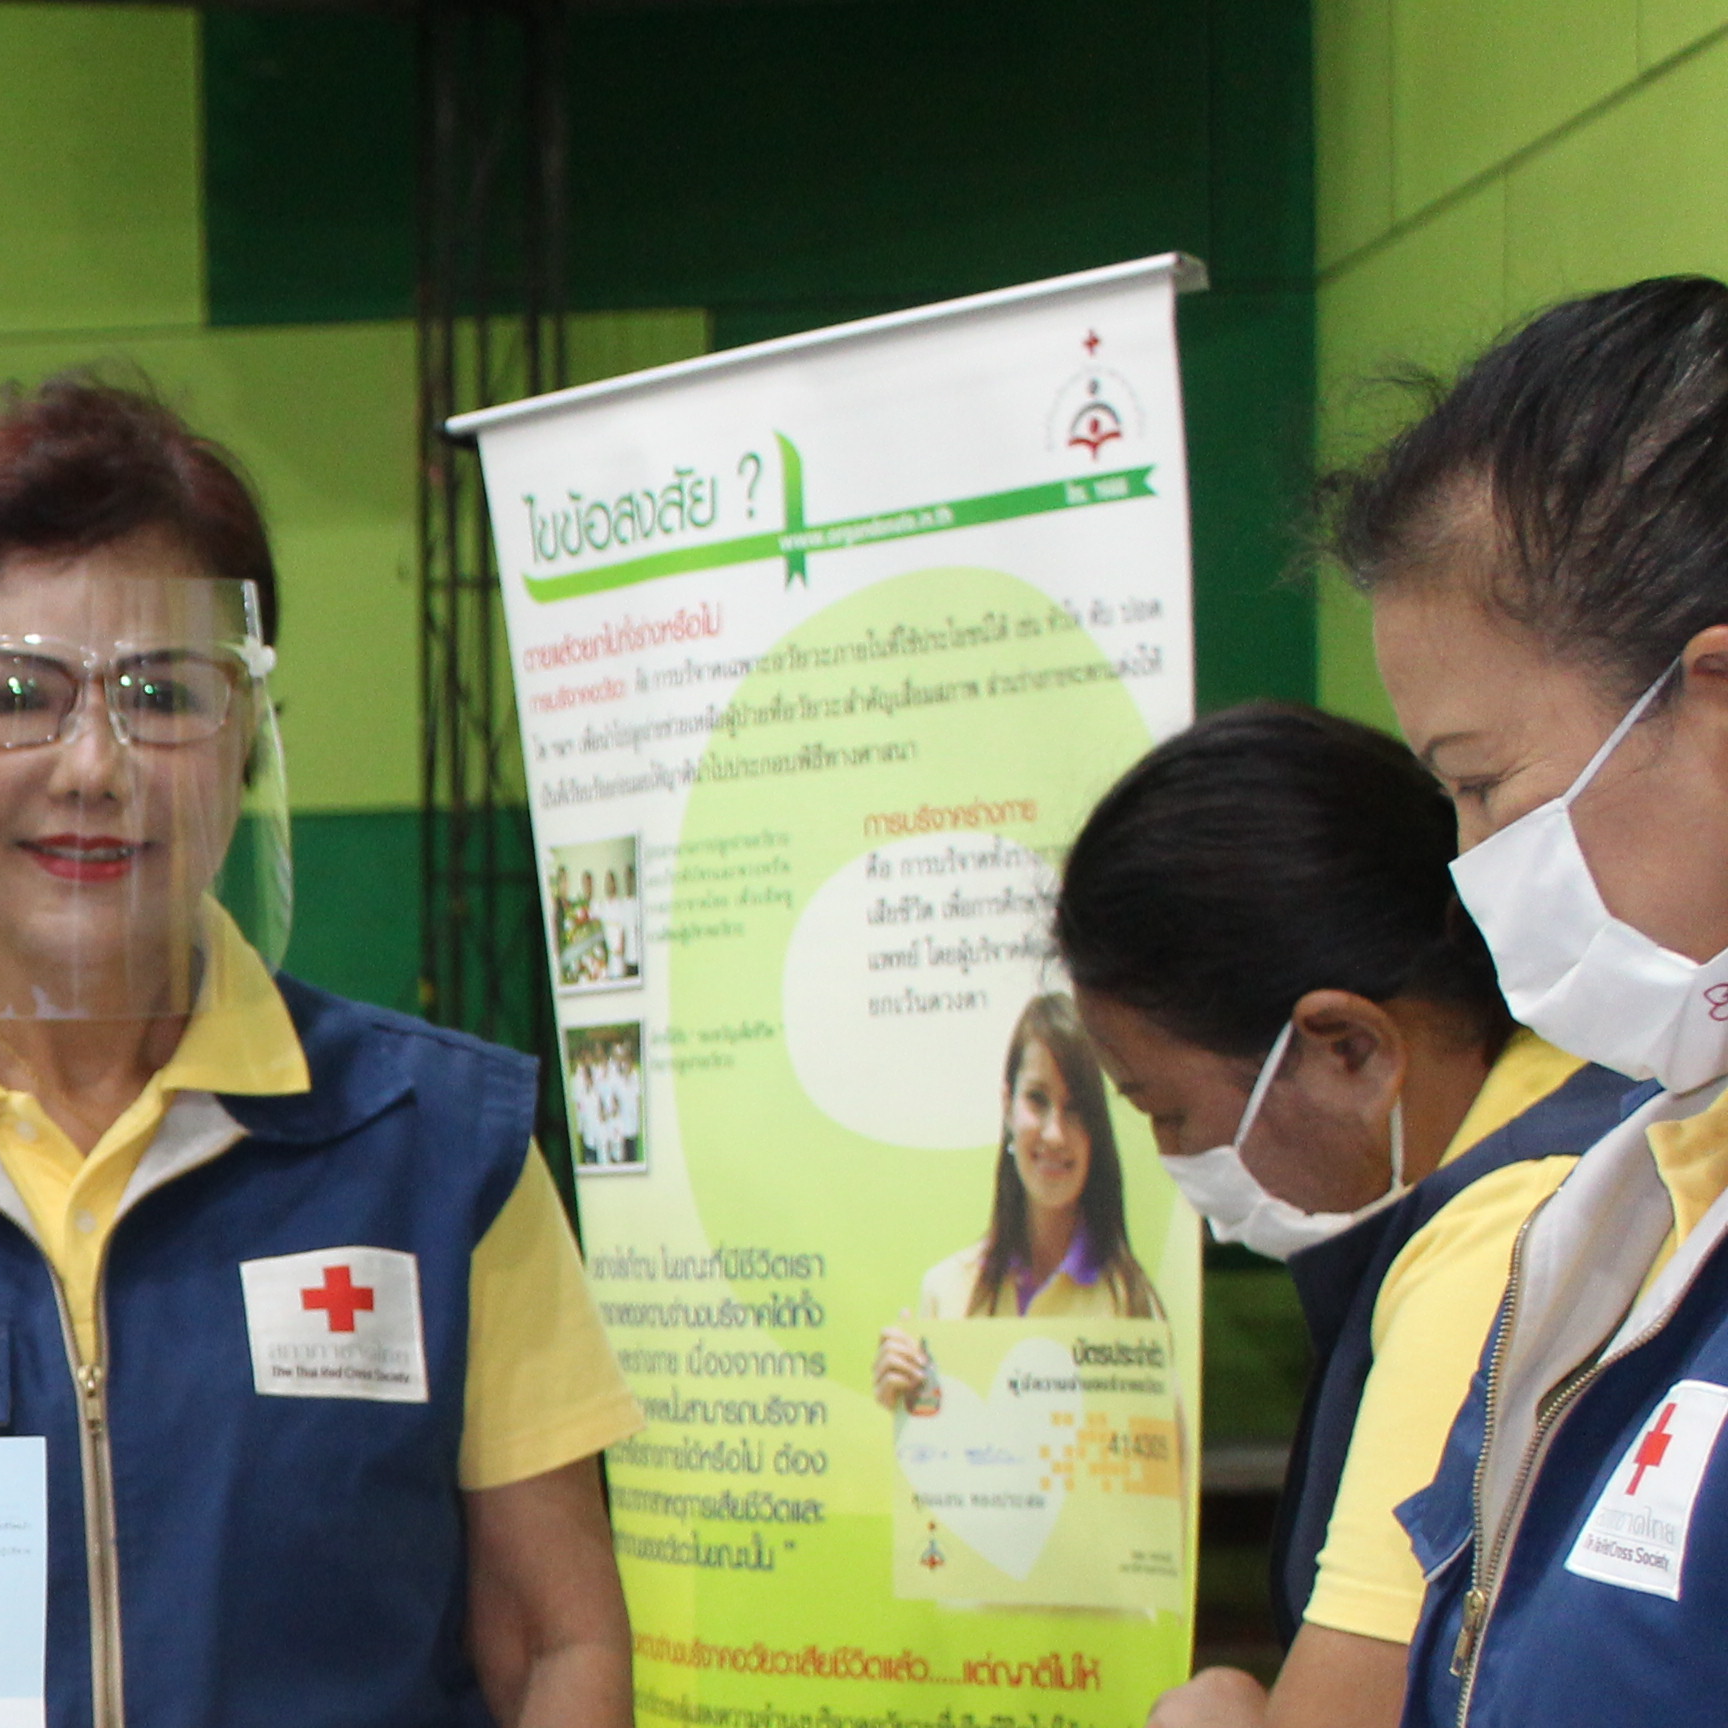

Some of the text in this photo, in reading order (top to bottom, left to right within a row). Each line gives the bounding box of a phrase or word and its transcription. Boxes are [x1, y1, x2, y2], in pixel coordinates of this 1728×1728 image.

[521, 452, 761, 564] ไขข้อสงสัย ?
[774, 1440, 827, 1476] ต้อง
